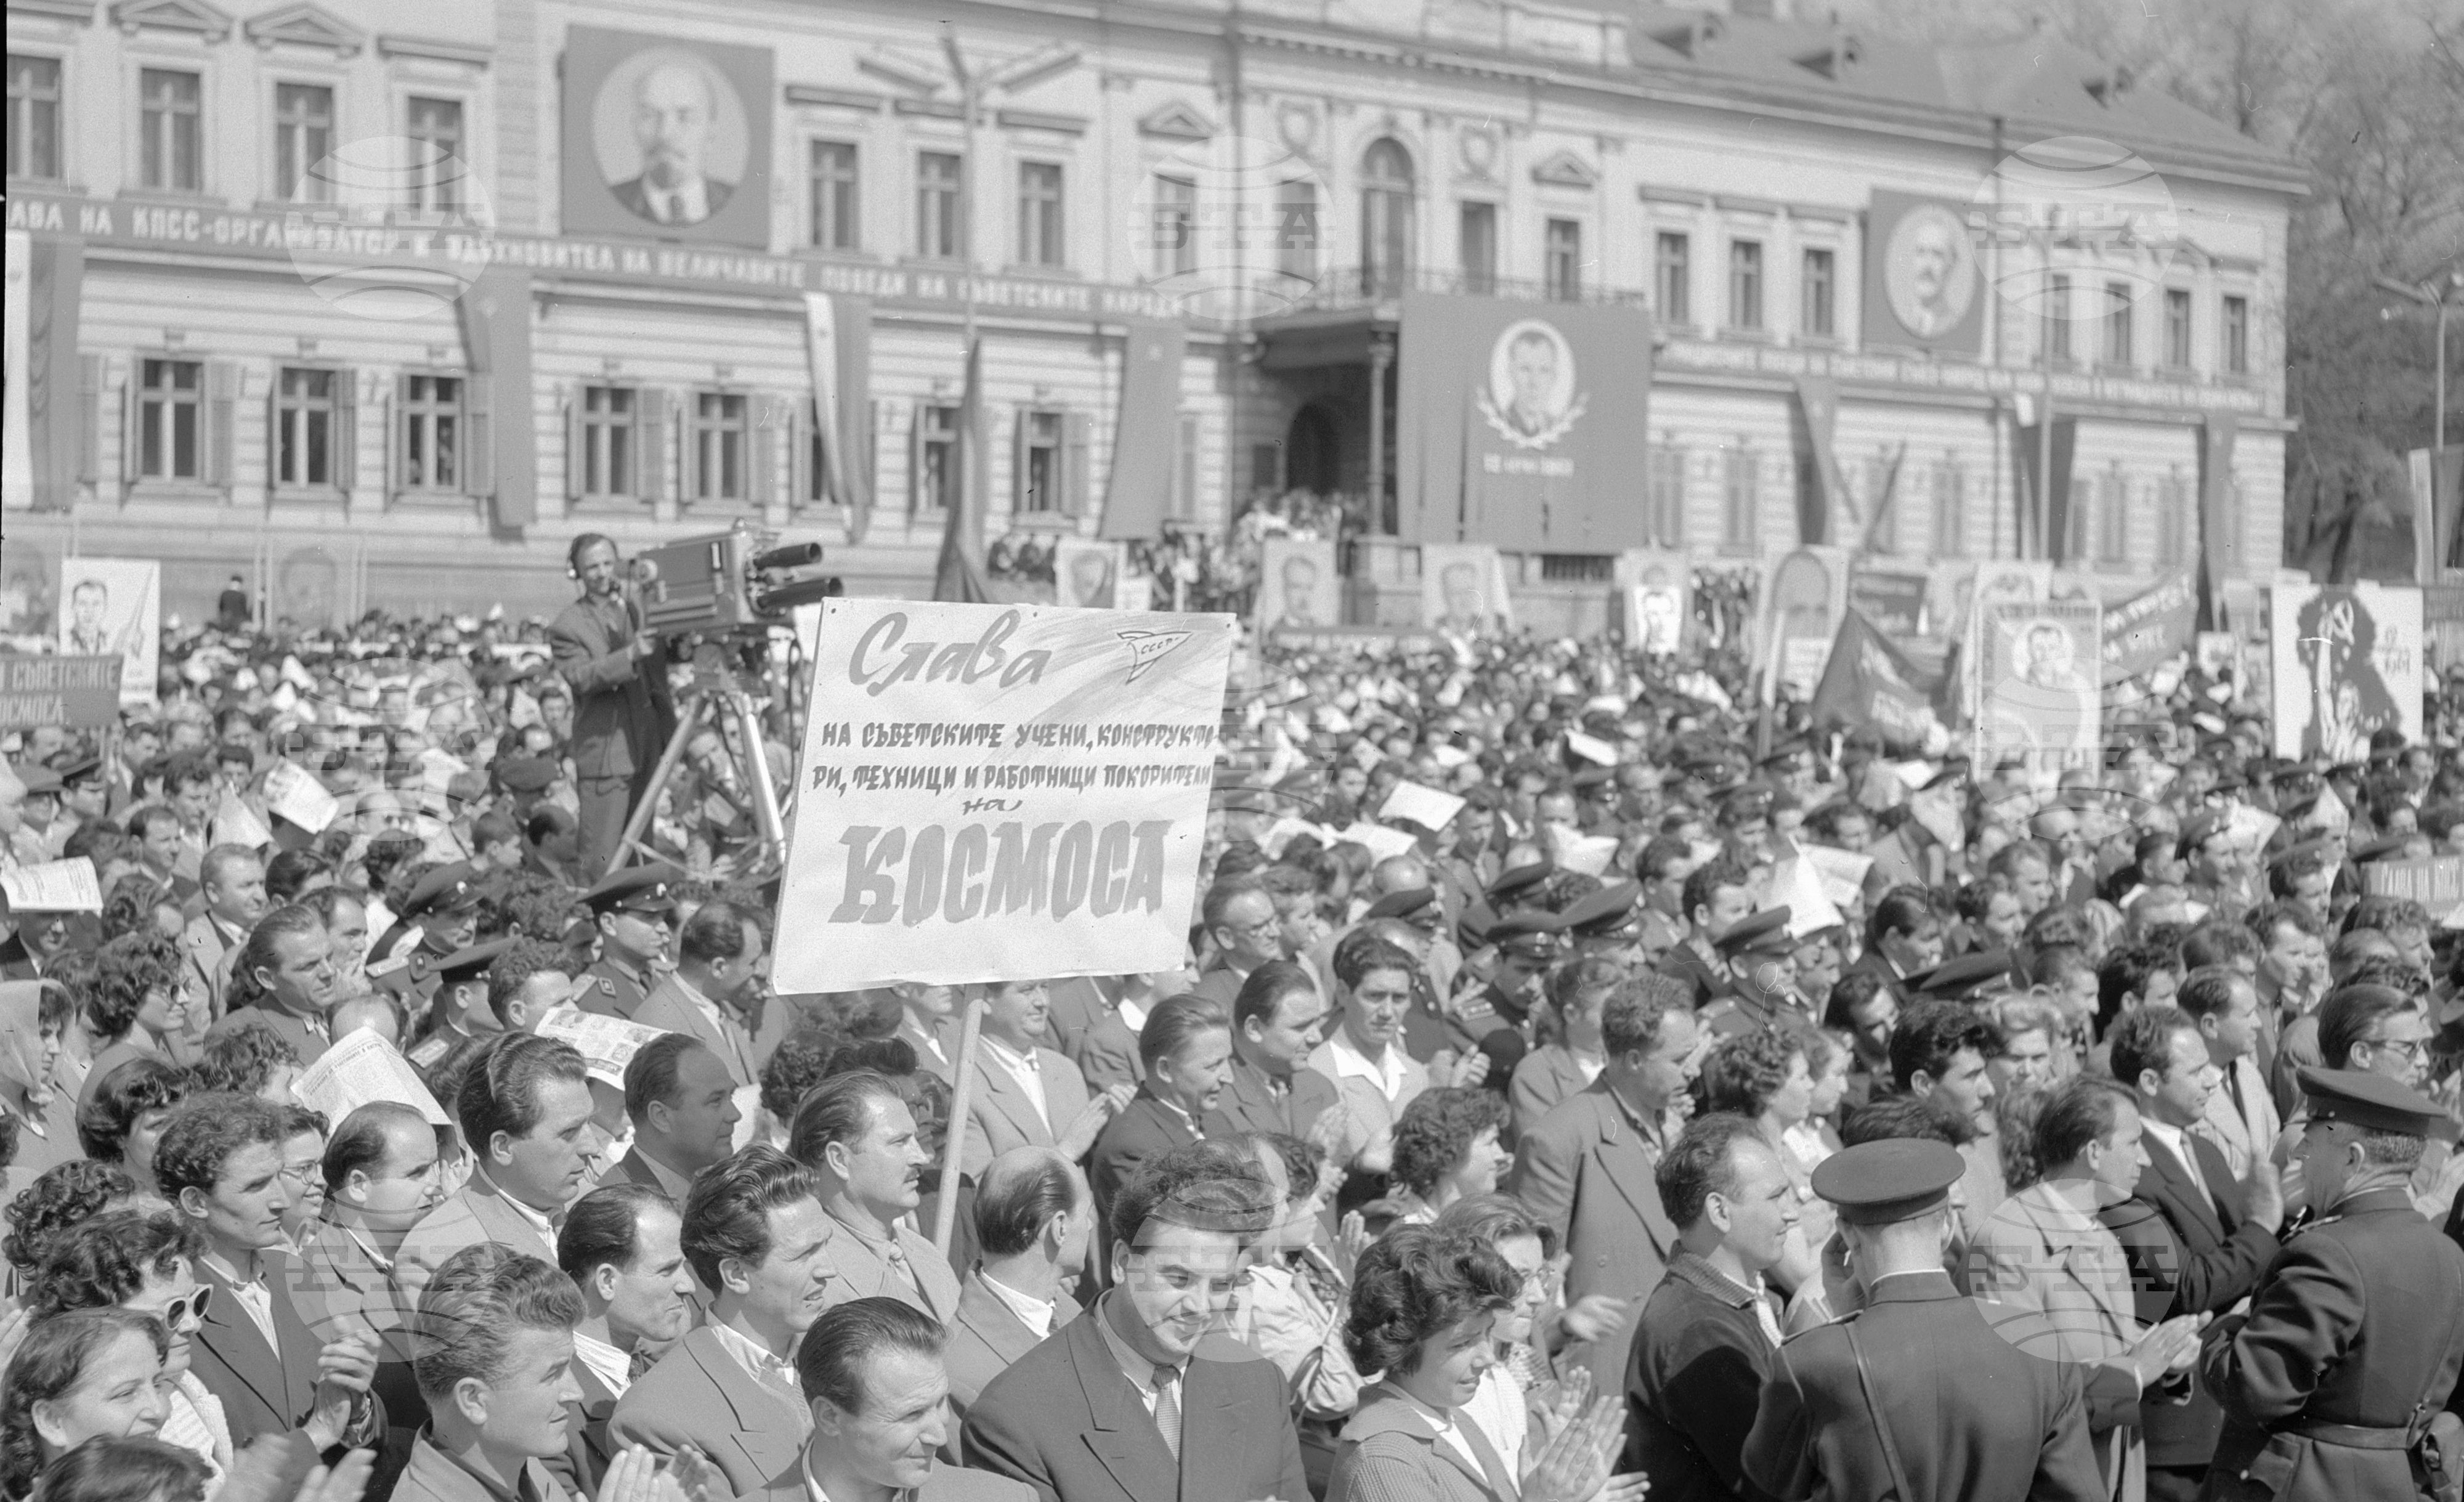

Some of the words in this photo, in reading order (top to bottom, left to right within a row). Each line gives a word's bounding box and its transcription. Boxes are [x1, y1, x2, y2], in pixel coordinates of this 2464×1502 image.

[79, 206, 113, 236] НА
[848, 609, 1052, 697] Слава
[822, 722, 851, 747] НА
[862, 722, 1005, 748] СЪВЕТСКИТЕ
[1014, 723, 1093, 752] УЧЕНИ,
[813, 765, 847, 798] РИ,
[852, 765, 957, 797] ТЕХНИЦИ
[964, 765, 979, 789] И
[984, 765, 1098, 795] РАБОТНИЦИ
[1103, 764, 1212, 789] ПОКОРИТЕЛИ
[828, 819, 1175, 928] КОСМОСА
